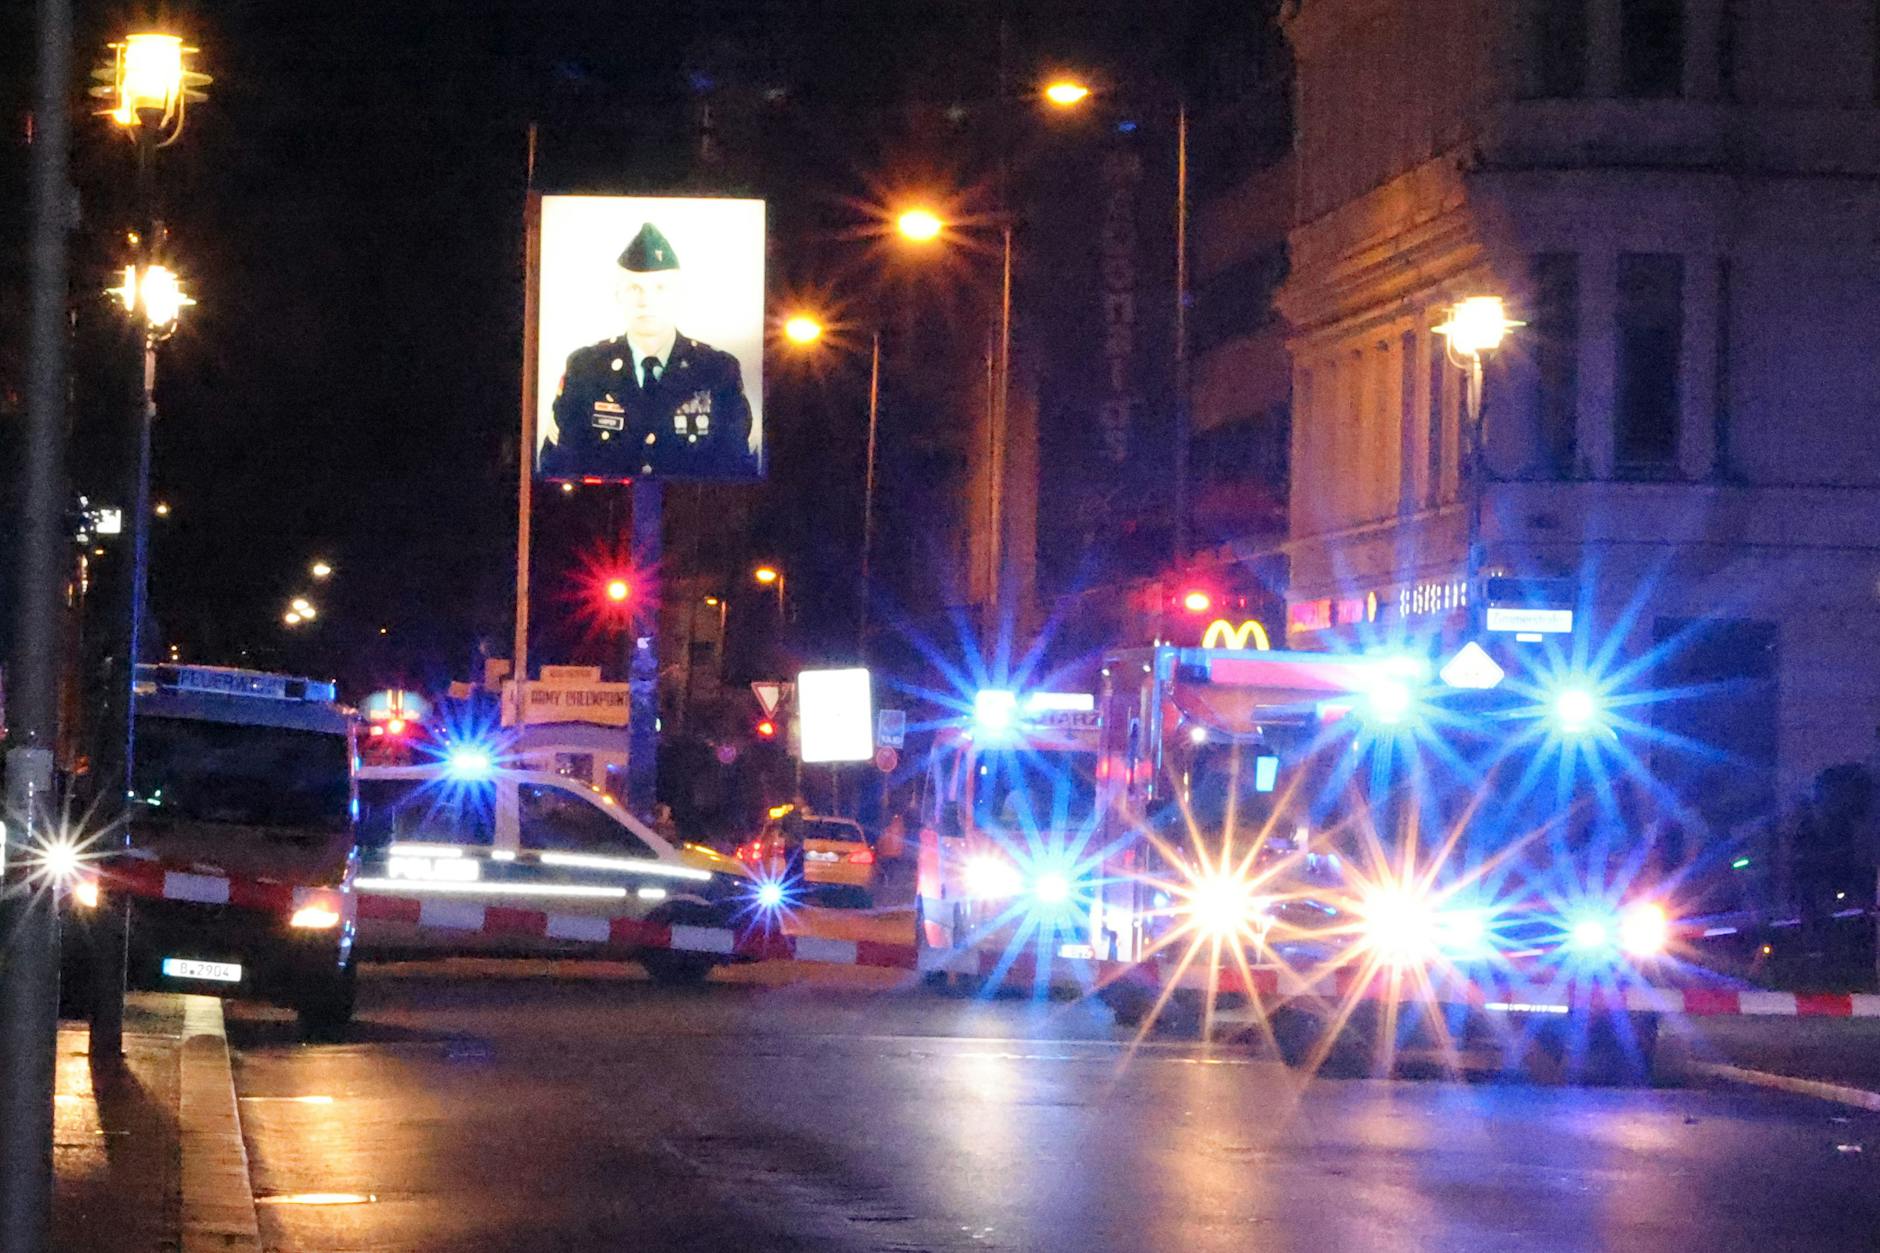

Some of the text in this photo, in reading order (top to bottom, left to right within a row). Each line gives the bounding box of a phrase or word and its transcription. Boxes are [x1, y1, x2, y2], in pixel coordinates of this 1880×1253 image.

[180, 669, 284, 696] FEUERWE
[531, 690, 561, 705] ARMY
[565, 690, 628, 706] CHECKPOINT
[197, 964, 229, 977] 2904
